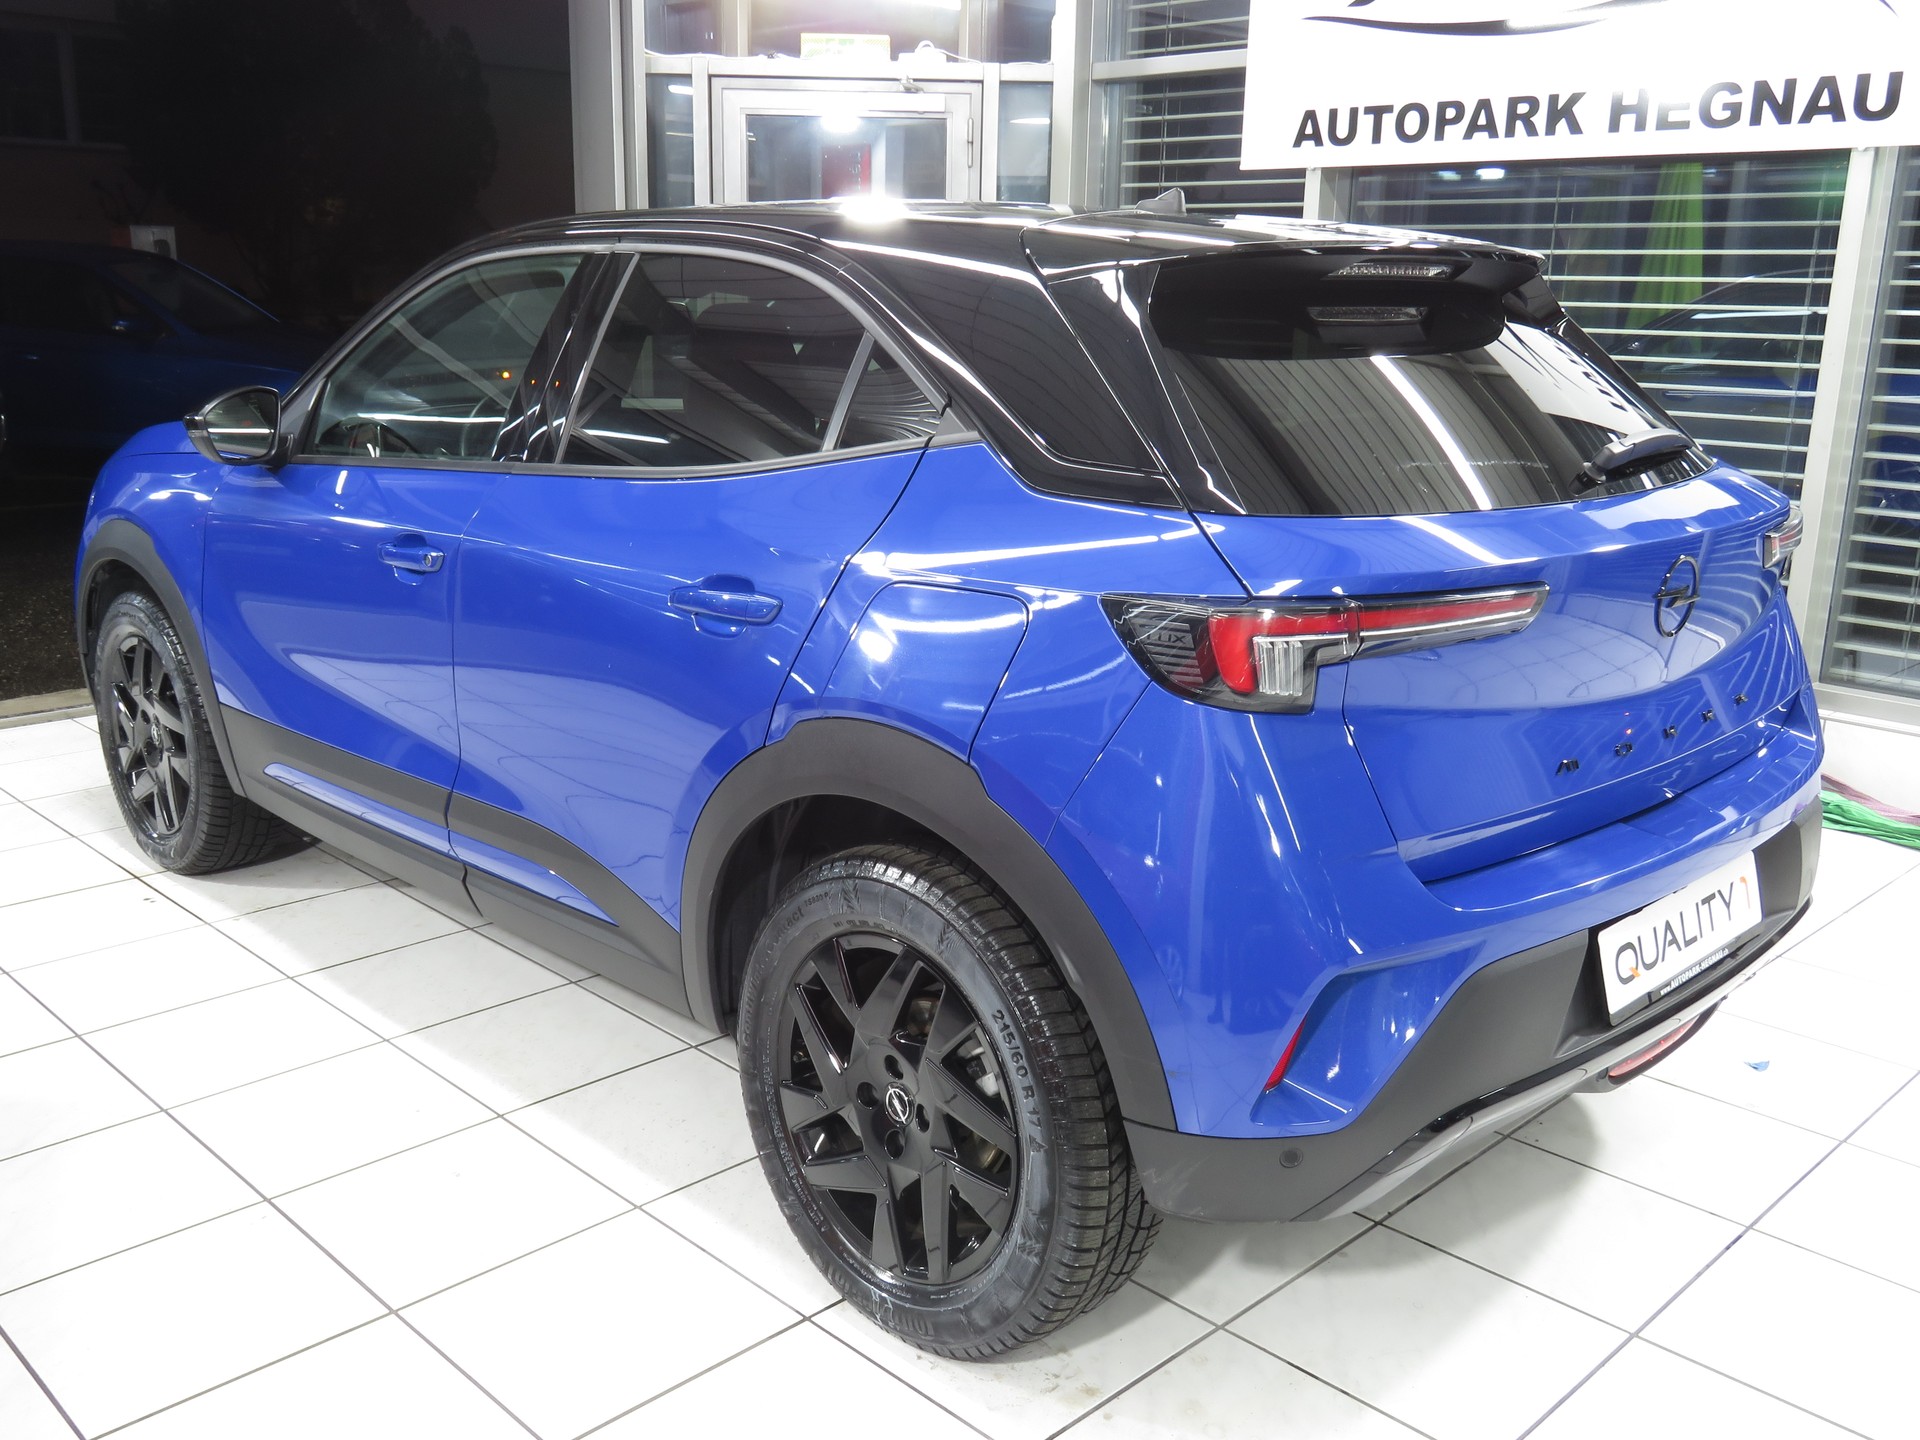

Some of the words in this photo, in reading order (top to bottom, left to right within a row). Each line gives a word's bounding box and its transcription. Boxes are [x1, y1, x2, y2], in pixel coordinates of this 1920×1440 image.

[1292, 92, 1586, 148] AUTOPARK
[1607, 71, 1904, 133] HEGNAU
[991, 1009, 1029, 1079] 215/60
[1021, 1085, 1036, 1102] R
[1027, 1107, 1043, 1129] 17
